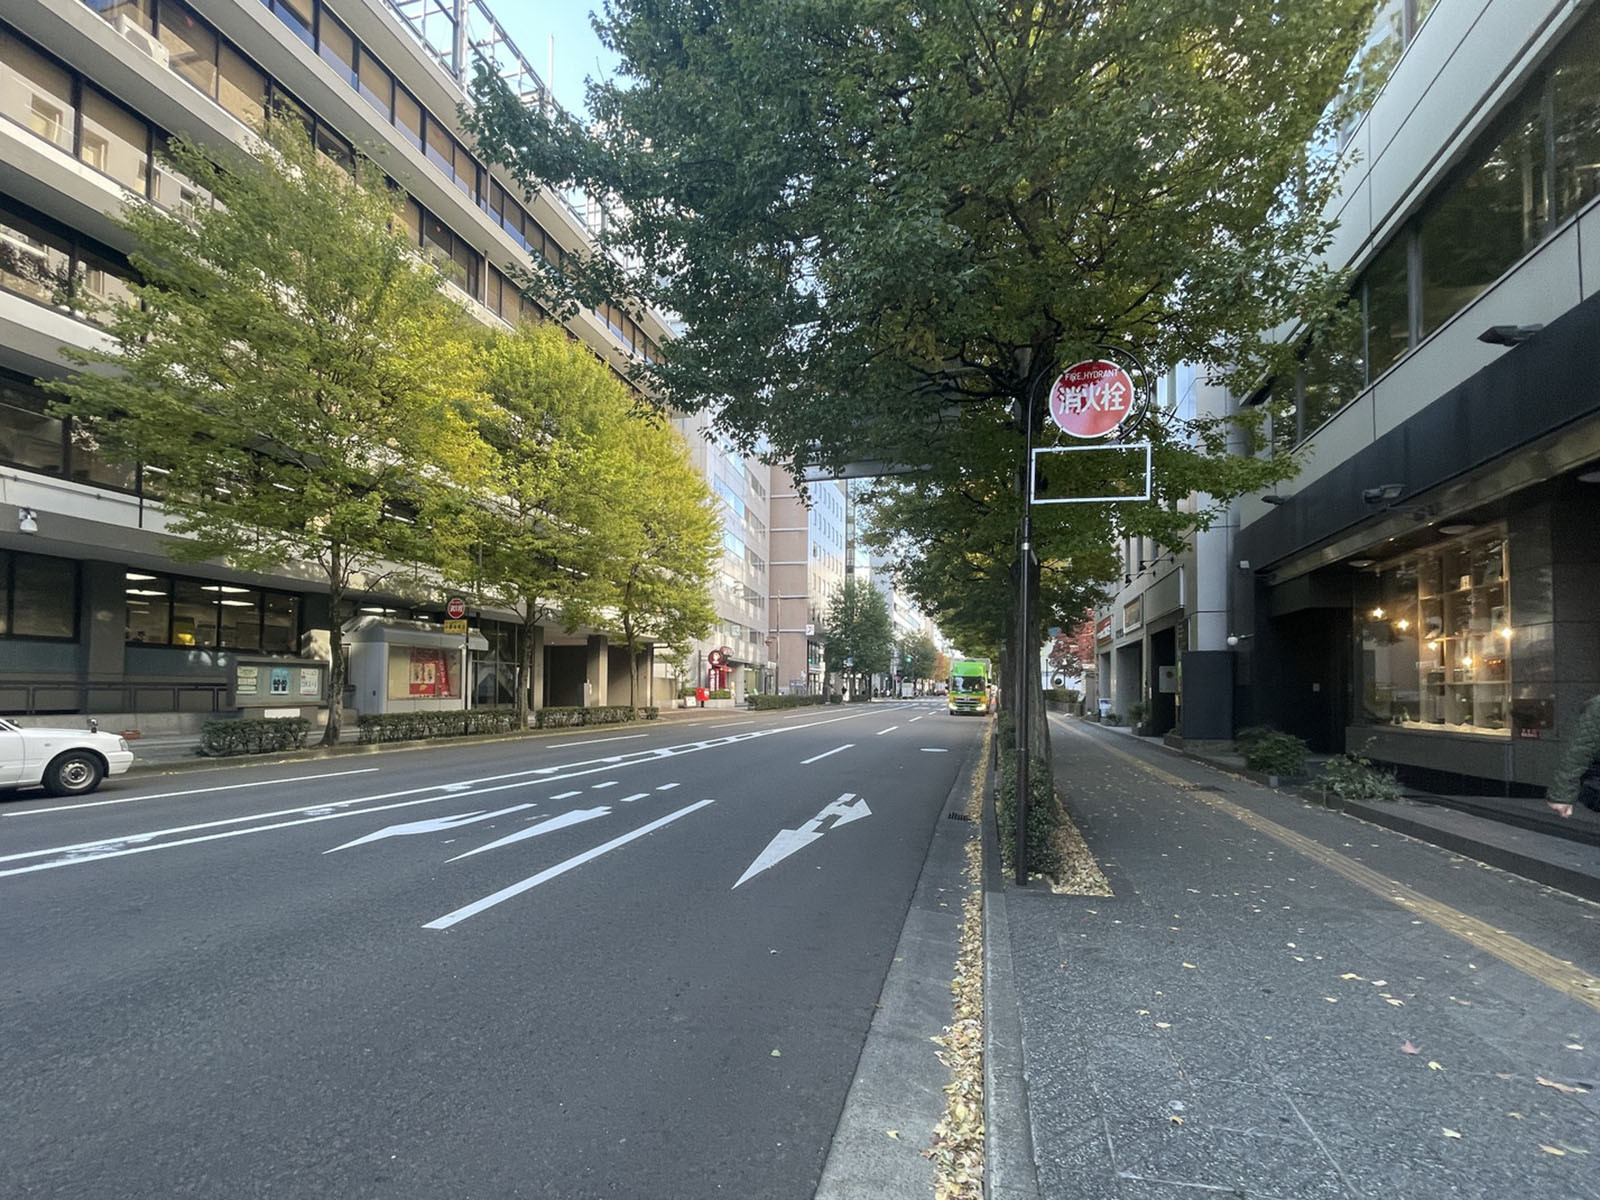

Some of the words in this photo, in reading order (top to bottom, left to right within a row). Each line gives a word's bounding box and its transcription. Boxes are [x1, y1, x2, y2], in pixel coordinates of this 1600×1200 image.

[1064, 372, 1082, 381] FIRE
[1084, 369, 1118, 379] HYDRANT
[1058, 382, 1126, 414] 消火栓
